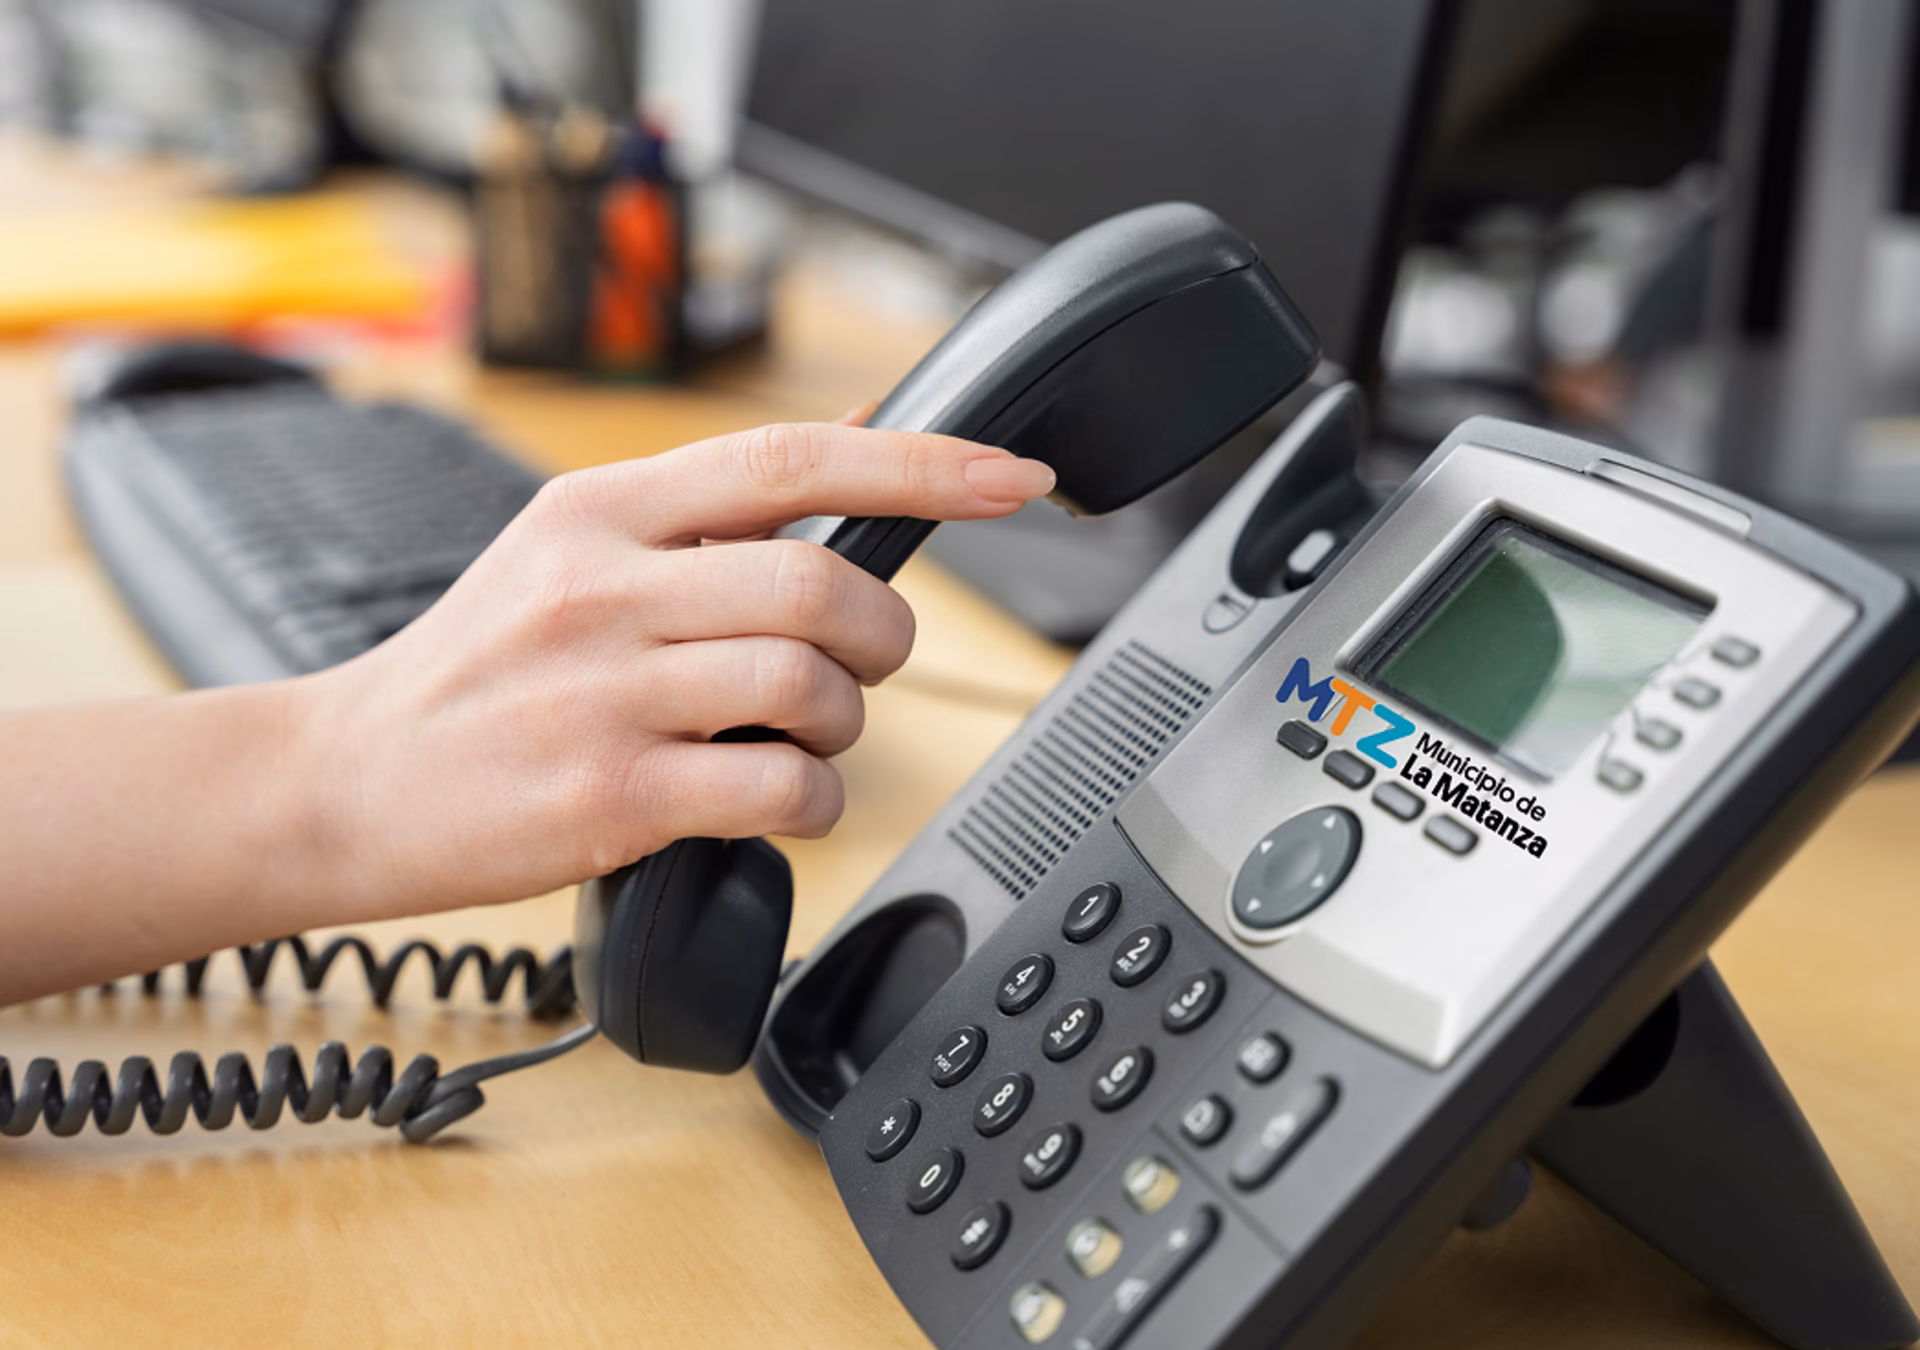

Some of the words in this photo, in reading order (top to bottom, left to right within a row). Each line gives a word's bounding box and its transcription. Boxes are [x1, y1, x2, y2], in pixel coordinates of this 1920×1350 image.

[1080, 895, 1099, 916] 1
[1126, 936, 1151, 961] 2
[1016, 965, 1036, 986] 4
[1181, 981, 1206, 1007] 3
[1061, 1008, 1085, 1032] 5
[948, 1034, 970, 1057] 7
[1110, 1056, 1135, 1082] 6
[992, 1083, 1015, 1107] 8
[1038, 1134, 1063, 1160] 9
